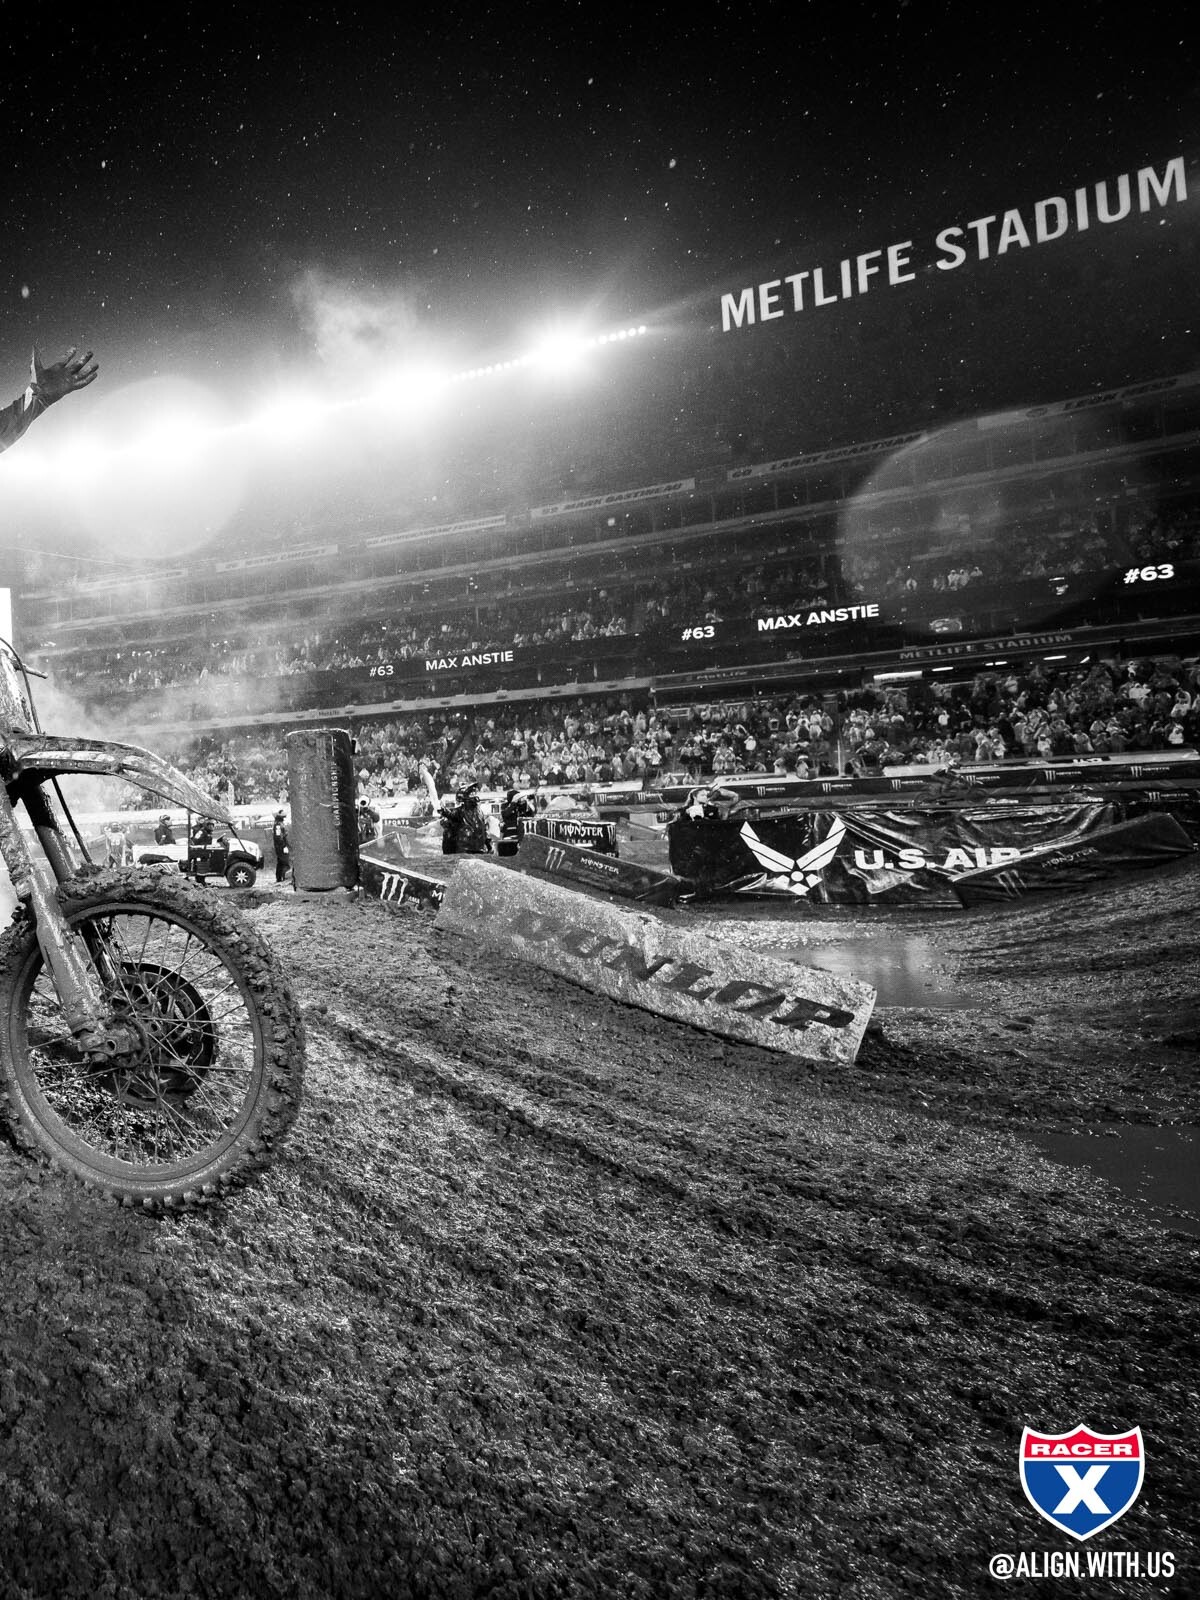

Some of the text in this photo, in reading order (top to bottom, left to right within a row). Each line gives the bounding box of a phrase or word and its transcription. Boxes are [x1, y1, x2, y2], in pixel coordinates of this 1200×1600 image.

[720, 156, 1188, 333] METLIFE STADIUM
[1123, 563, 1175, 584] #63
[757, 603, 880, 633] MAX ANSTIE
[680, 625, 716, 641] #63
[899, 632, 1073, 660] METLIFE STADIUM
[369, 664, 394, 677] #63
[424, 650, 514, 671] MAX ANSTIE
[559, 823, 604, 838] MONSTER
[580, 857, 620, 875] MONSTER
[854, 848, 936, 871] U.S.
[1041, 847, 1099, 869] MONSTER
